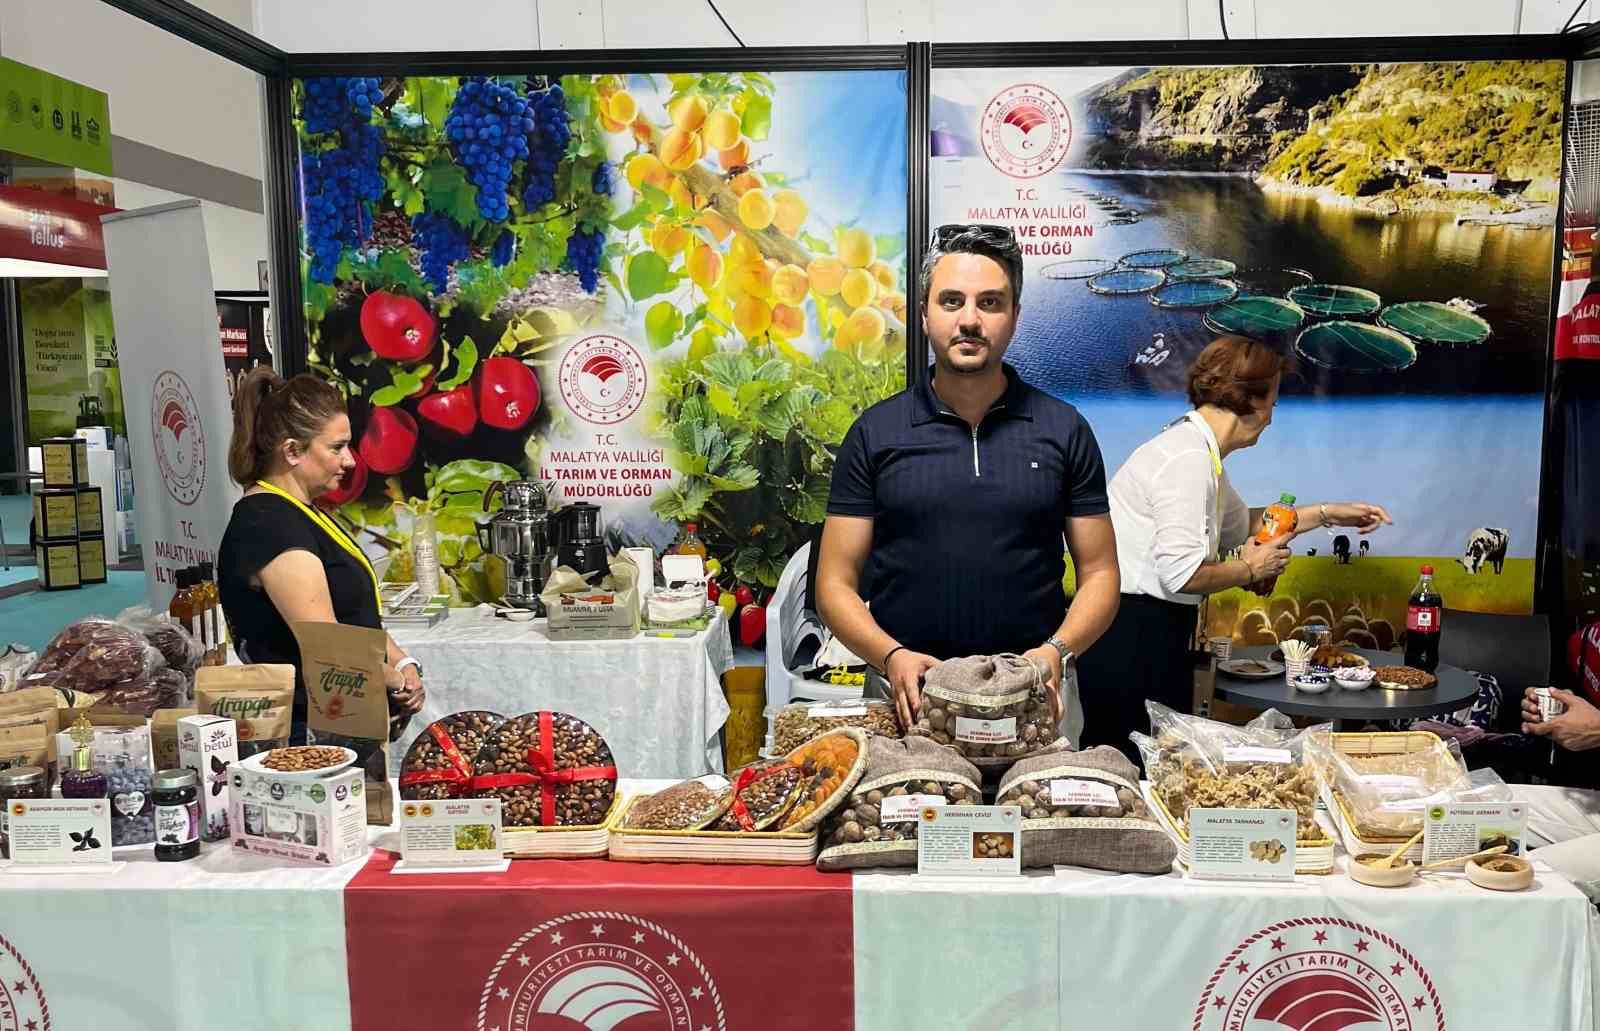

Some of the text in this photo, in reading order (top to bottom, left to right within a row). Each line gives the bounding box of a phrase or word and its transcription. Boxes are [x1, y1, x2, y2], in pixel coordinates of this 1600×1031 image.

[1015, 188, 1038, 201] T.C.
[967, 204, 1087, 219] MALATYA VALİLİĞİ
[30, 223, 65, 249] Tellus
[1019, 225, 1093, 237] VE ORMAN
[1021, 241, 1072, 255] RLÜĞÜ
[595, 434, 618, 446] T.C.
[550, 449, 664, 463] MALATYA VALİLİĞİ
[540, 467, 672, 480] İL TARIM VE ORMAN
[564, 483, 653, 497] MÜDÜRLÜĞÜ
[155, 541, 194, 564] MALATYA
[155, 562, 166, 582] İL
[512, 948, 688, 1031] MHURİYETİ TARIM VE ORMAN
[1229, 955, 1407, 1031] MHURİYETİ TARIM VE ORMA
